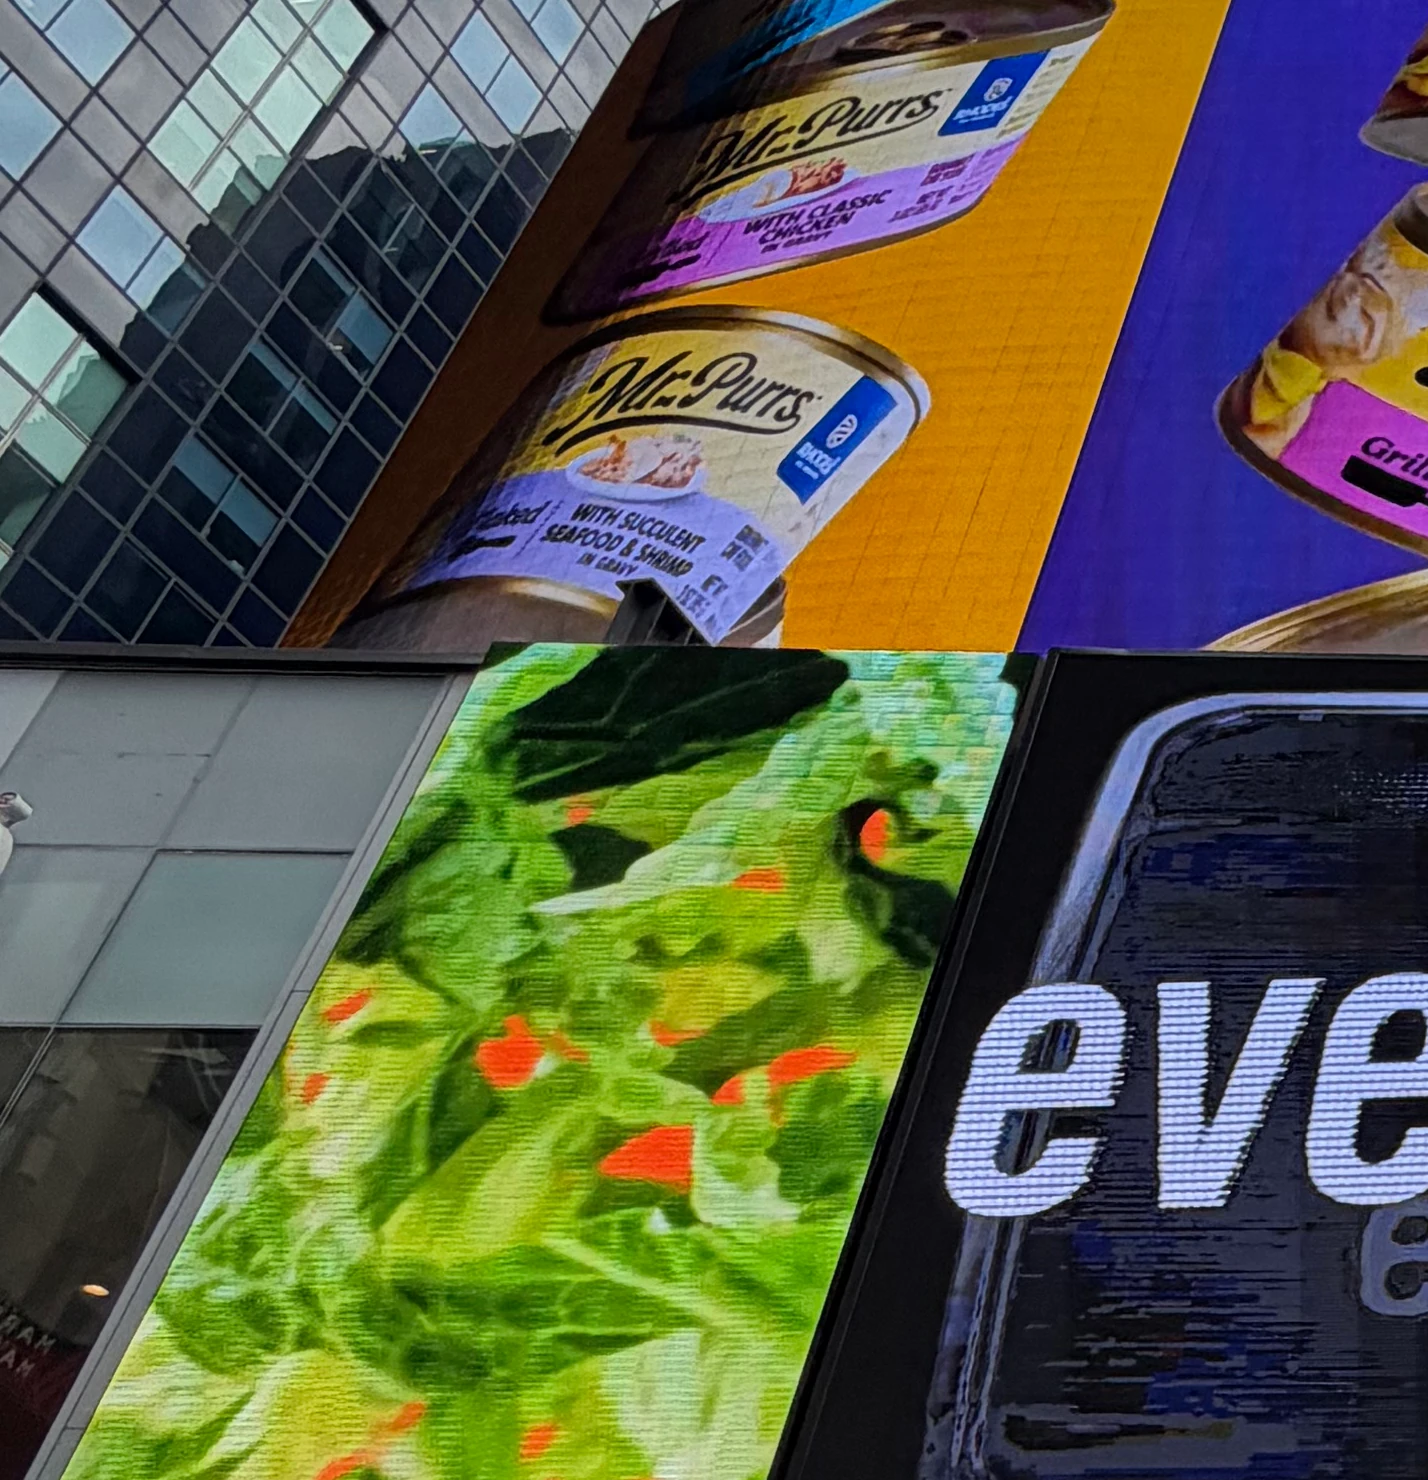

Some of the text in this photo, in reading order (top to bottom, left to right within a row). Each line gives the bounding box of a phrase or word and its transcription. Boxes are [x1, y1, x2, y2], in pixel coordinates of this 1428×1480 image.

[798, 95, 941, 153] Purrs
[743, 207, 804, 235] WITH
[806, 189, 893, 219] CLASSIC
[758, 213, 856, 245] CHICKEN
[676, 351, 814, 428] Purrs
[543, 523, 624, 560] SEAFOOD
[635, 544, 695, 580] SHRIMP
[570, 502, 707, 557] WITH SUCCULENT
